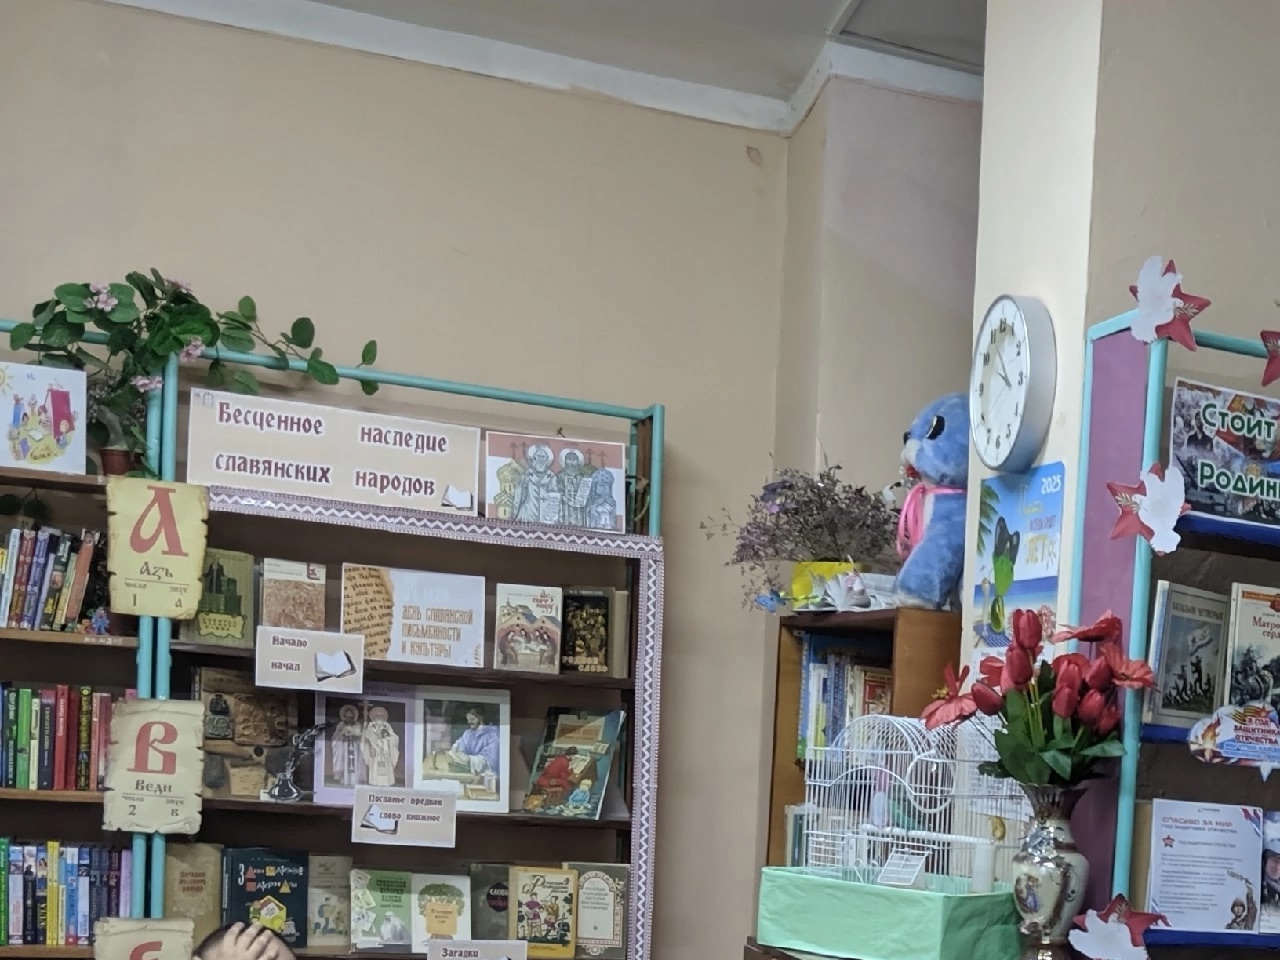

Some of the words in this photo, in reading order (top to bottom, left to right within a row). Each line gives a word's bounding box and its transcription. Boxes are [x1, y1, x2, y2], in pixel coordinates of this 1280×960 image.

[1018, 371, 1024, 386] 3
[979, 382, 984, 397] 9
[219, 402, 323, 435] Бесценное
[360, 426, 447, 453] наследие
[1201, 402, 1276, 440] Стоит
[995, 435, 1001, 449] 6
[215, 453, 331, 484] славянских
[355, 469, 435, 496] народов
[1041, 475, 1061, 495] 2025
[402, 623, 461, 642] ПИСЬМЕННОСТИ
[272, 635, 308, 648] Начало
[410, 642, 452, 658] КУЛЬТУРЫ
[271, 660, 301, 672] начал
[441, 948, 479, 959] Загадки
